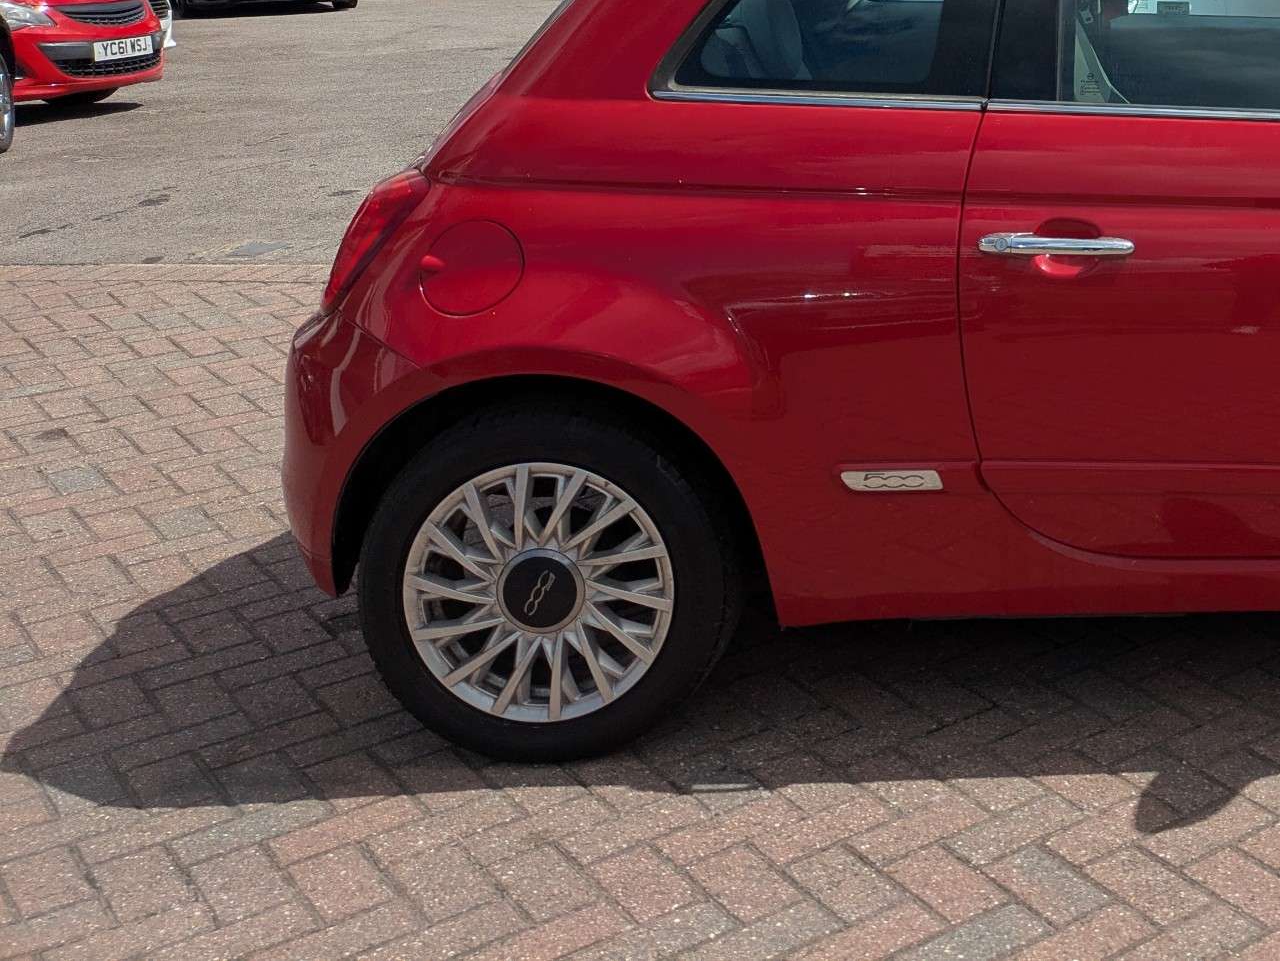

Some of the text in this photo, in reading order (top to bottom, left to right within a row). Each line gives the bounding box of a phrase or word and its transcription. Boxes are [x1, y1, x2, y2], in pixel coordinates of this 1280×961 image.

[102, 38, 148, 56] YC61 WSJ
[863, 473, 924, 489] 500
